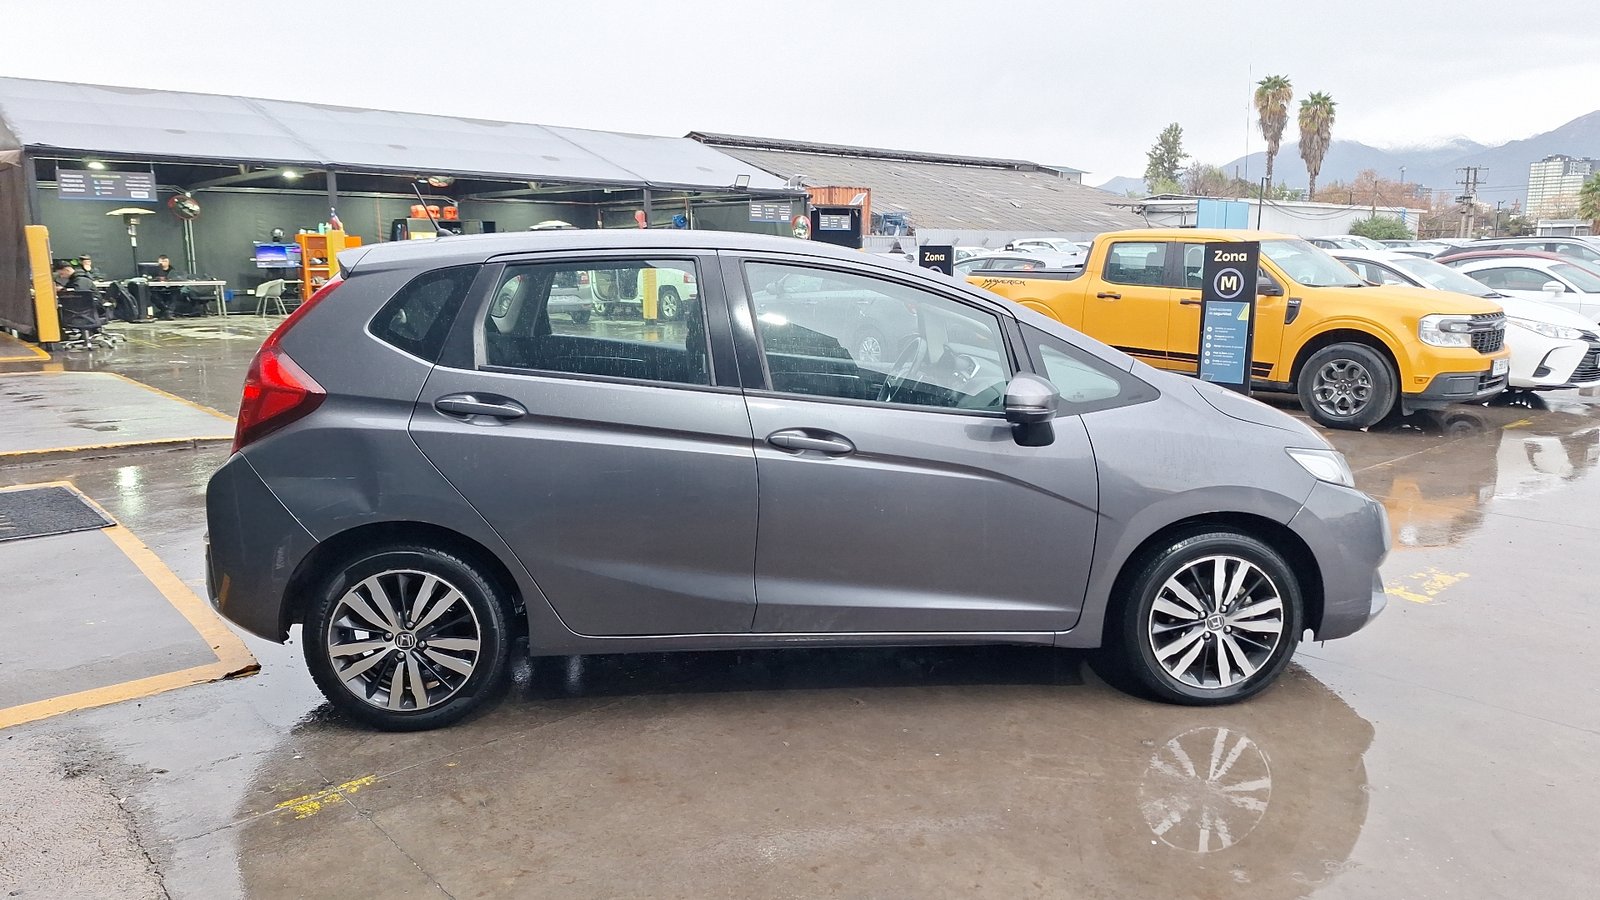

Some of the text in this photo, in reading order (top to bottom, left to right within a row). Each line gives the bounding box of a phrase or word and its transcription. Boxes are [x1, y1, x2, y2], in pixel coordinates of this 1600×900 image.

[924, 252, 945, 262] Zona
[1213, 250, 1248, 262] Zona
[1220, 275, 1238, 291] M
